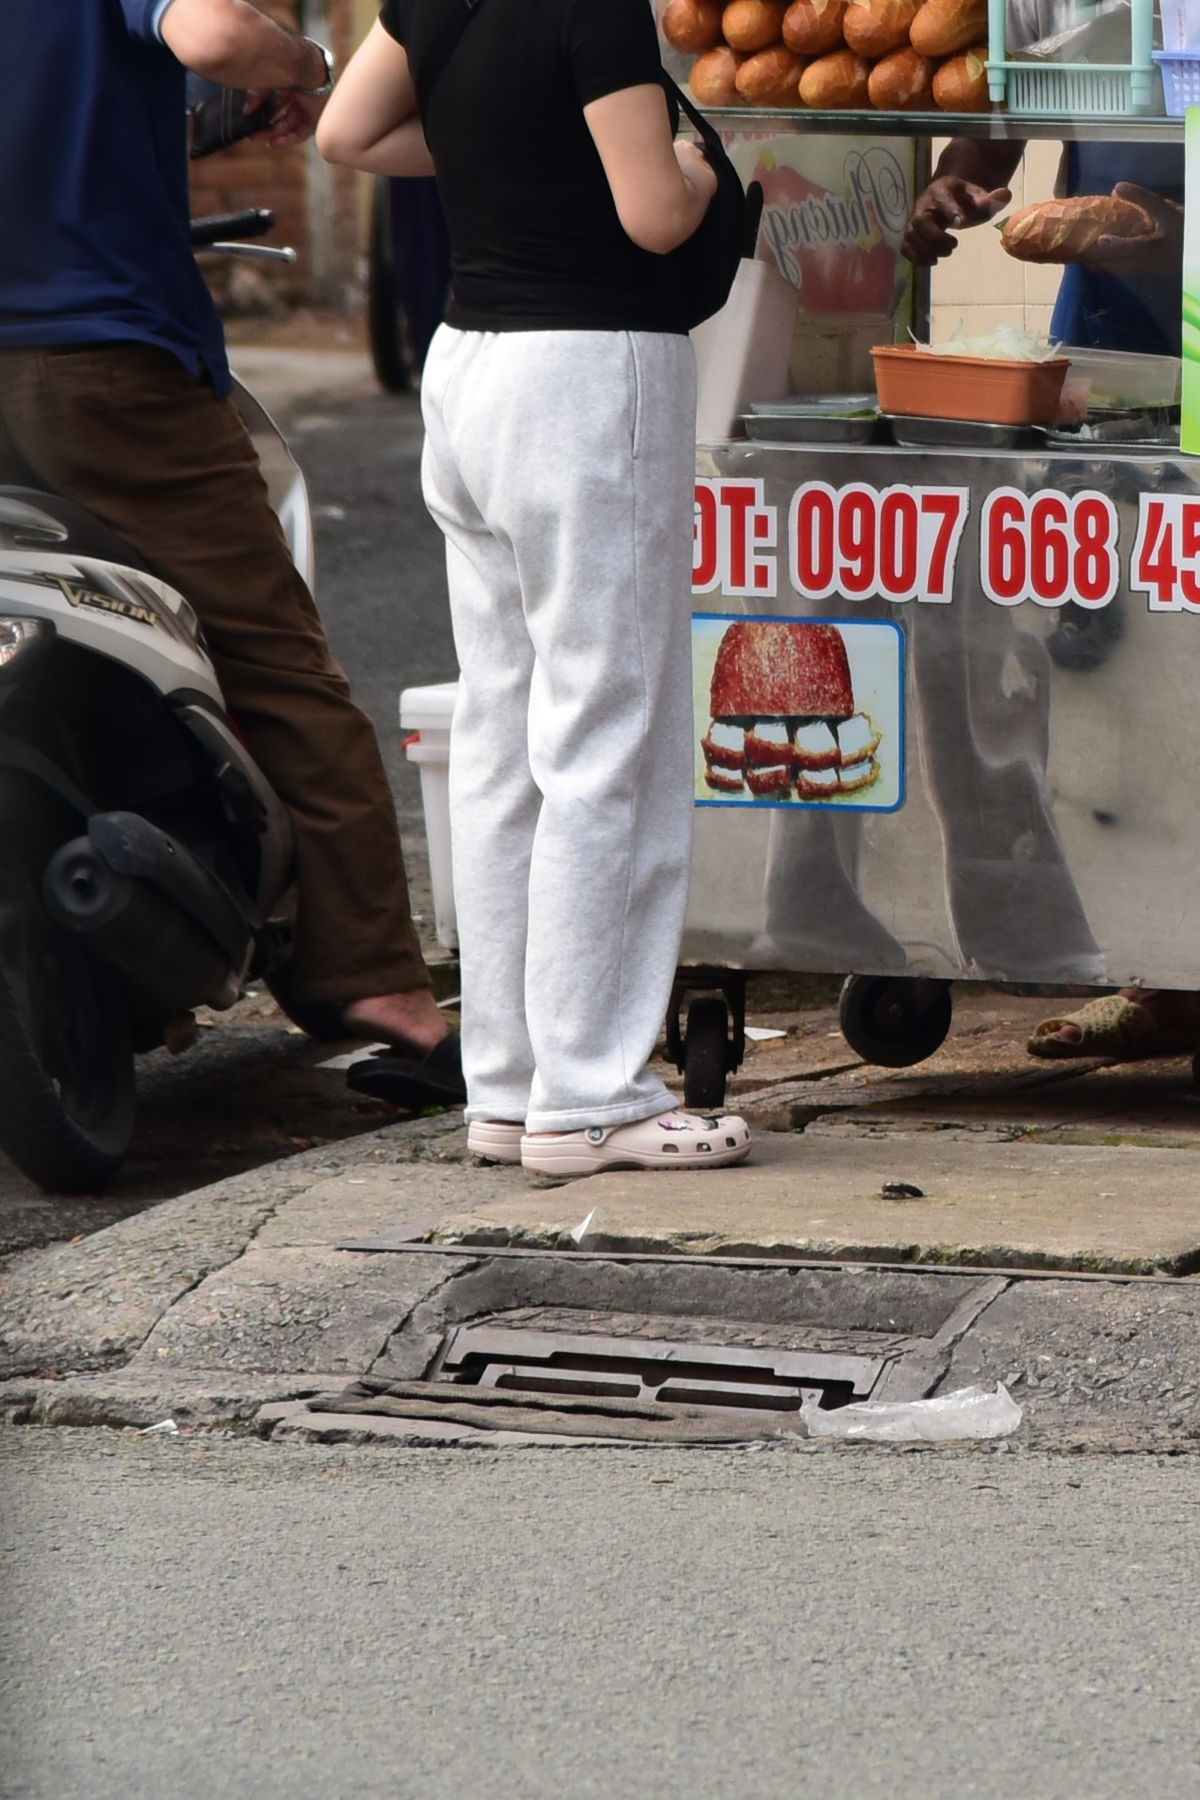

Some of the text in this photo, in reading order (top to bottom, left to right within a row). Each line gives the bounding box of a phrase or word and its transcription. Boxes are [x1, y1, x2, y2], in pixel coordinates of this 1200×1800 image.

[796, 489, 960, 595] 0907
[988, 495, 1110, 602] 668
[45, 574, 156, 626] VISION
